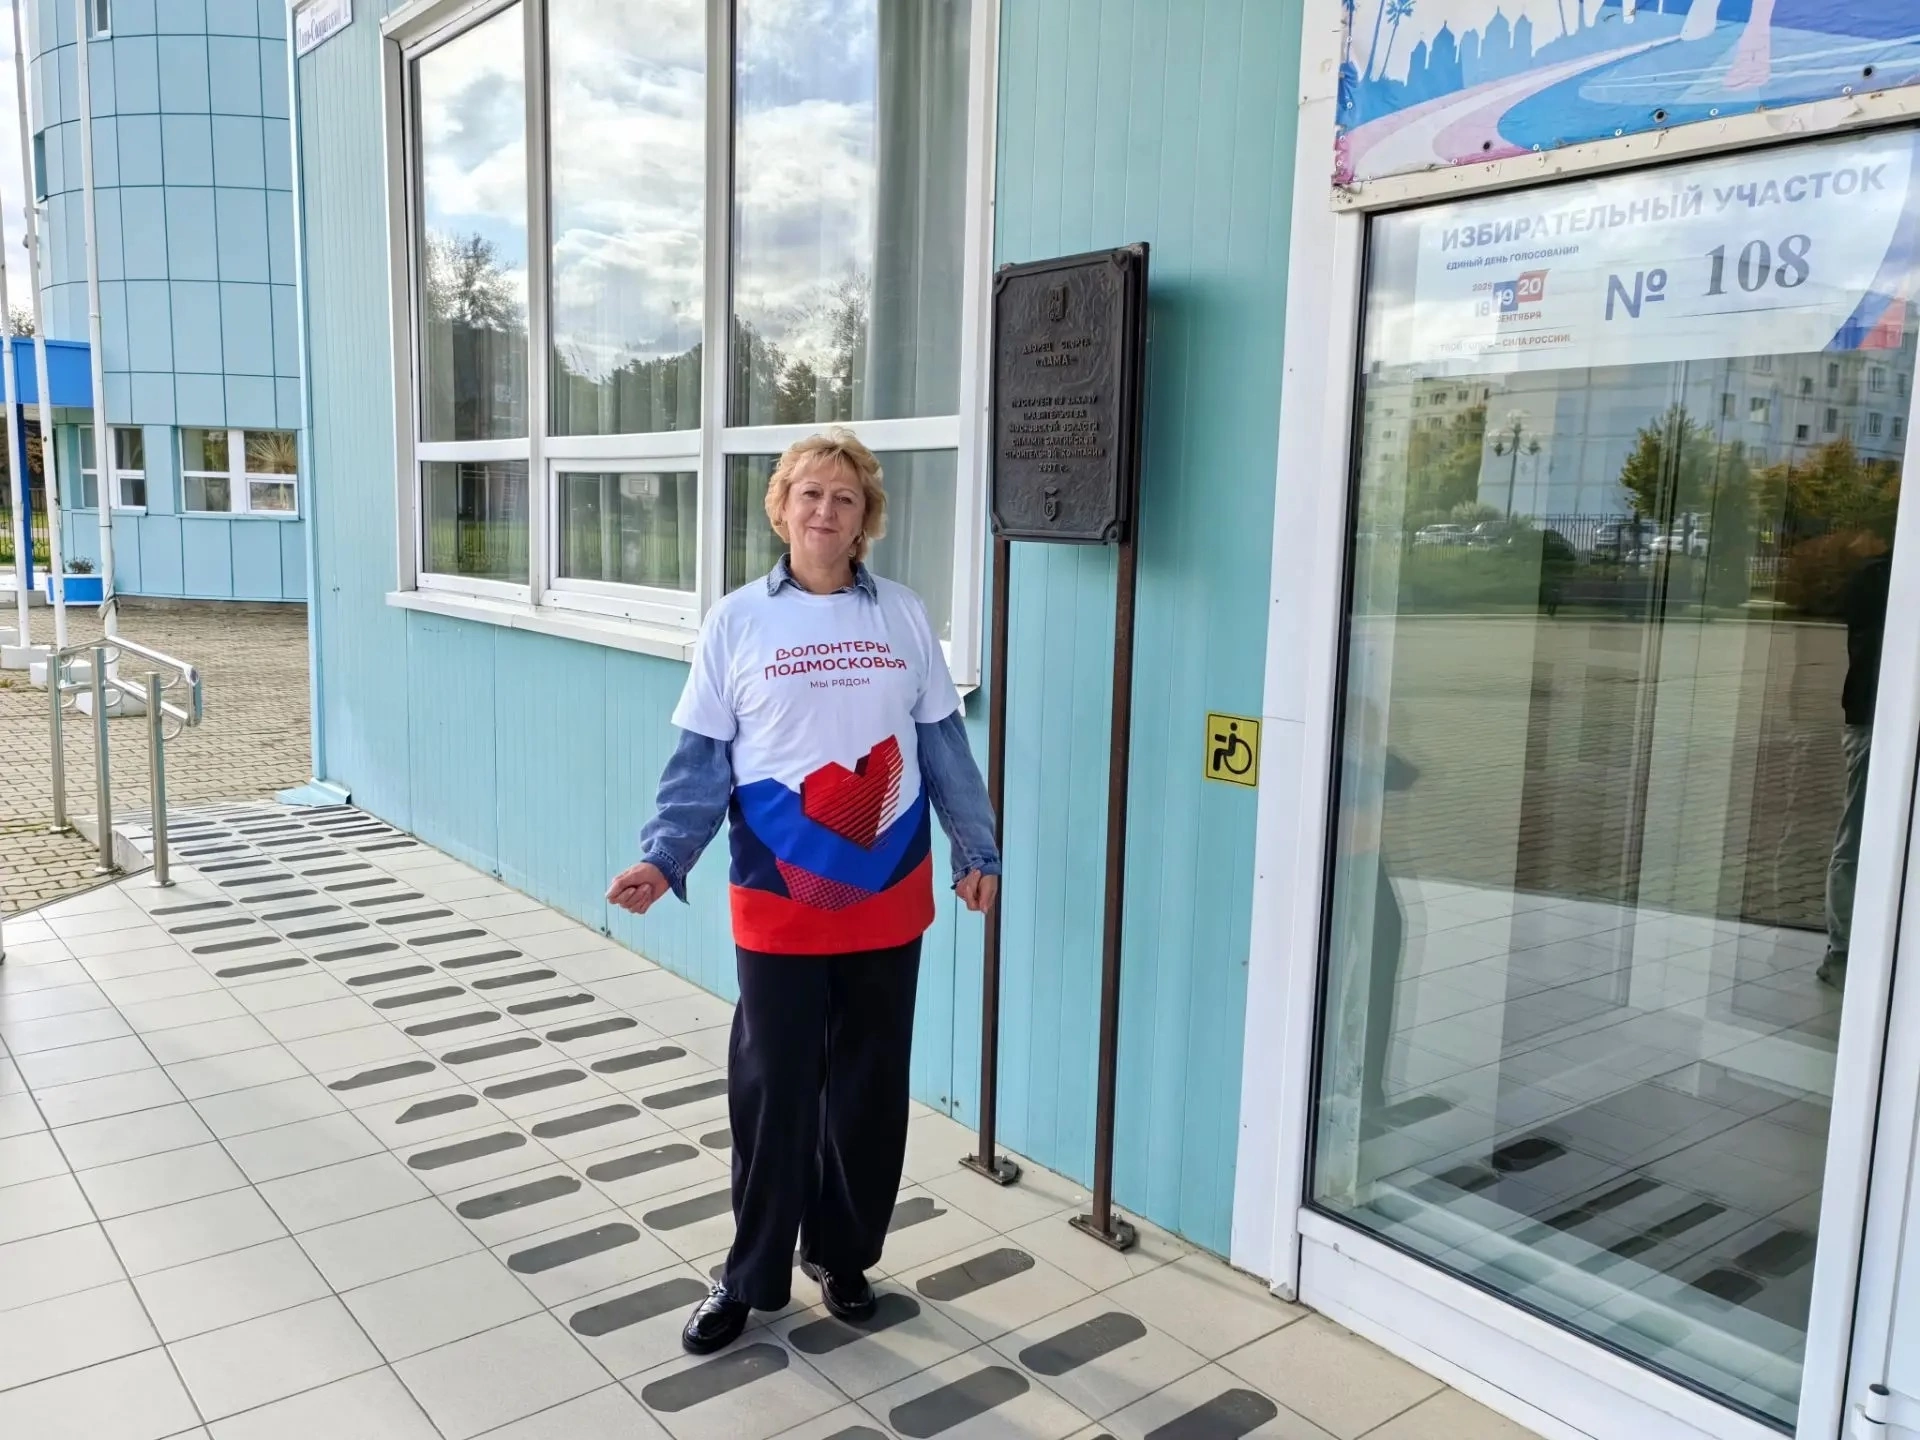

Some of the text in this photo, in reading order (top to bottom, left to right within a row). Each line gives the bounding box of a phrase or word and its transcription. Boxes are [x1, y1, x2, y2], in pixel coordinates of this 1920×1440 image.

[1441, 163, 1888, 251] ИЗБИРАТЕЛЬНЫЙ УЧАСТОК
[1446, 245, 1580, 270] ЕДИНЫЙ ДЕНЬ ГОЛОСОВАНИЯ
[1701, 234, 1811, 297] 108
[1518, 278, 1542, 295] 20
[775, 641, 891, 661] ВОЛОНТЕРЫ
[764, 656, 907, 681] ПОДМОСКОВЬЯ
[810, 677, 871, 689] МЫ РЯДОМ
